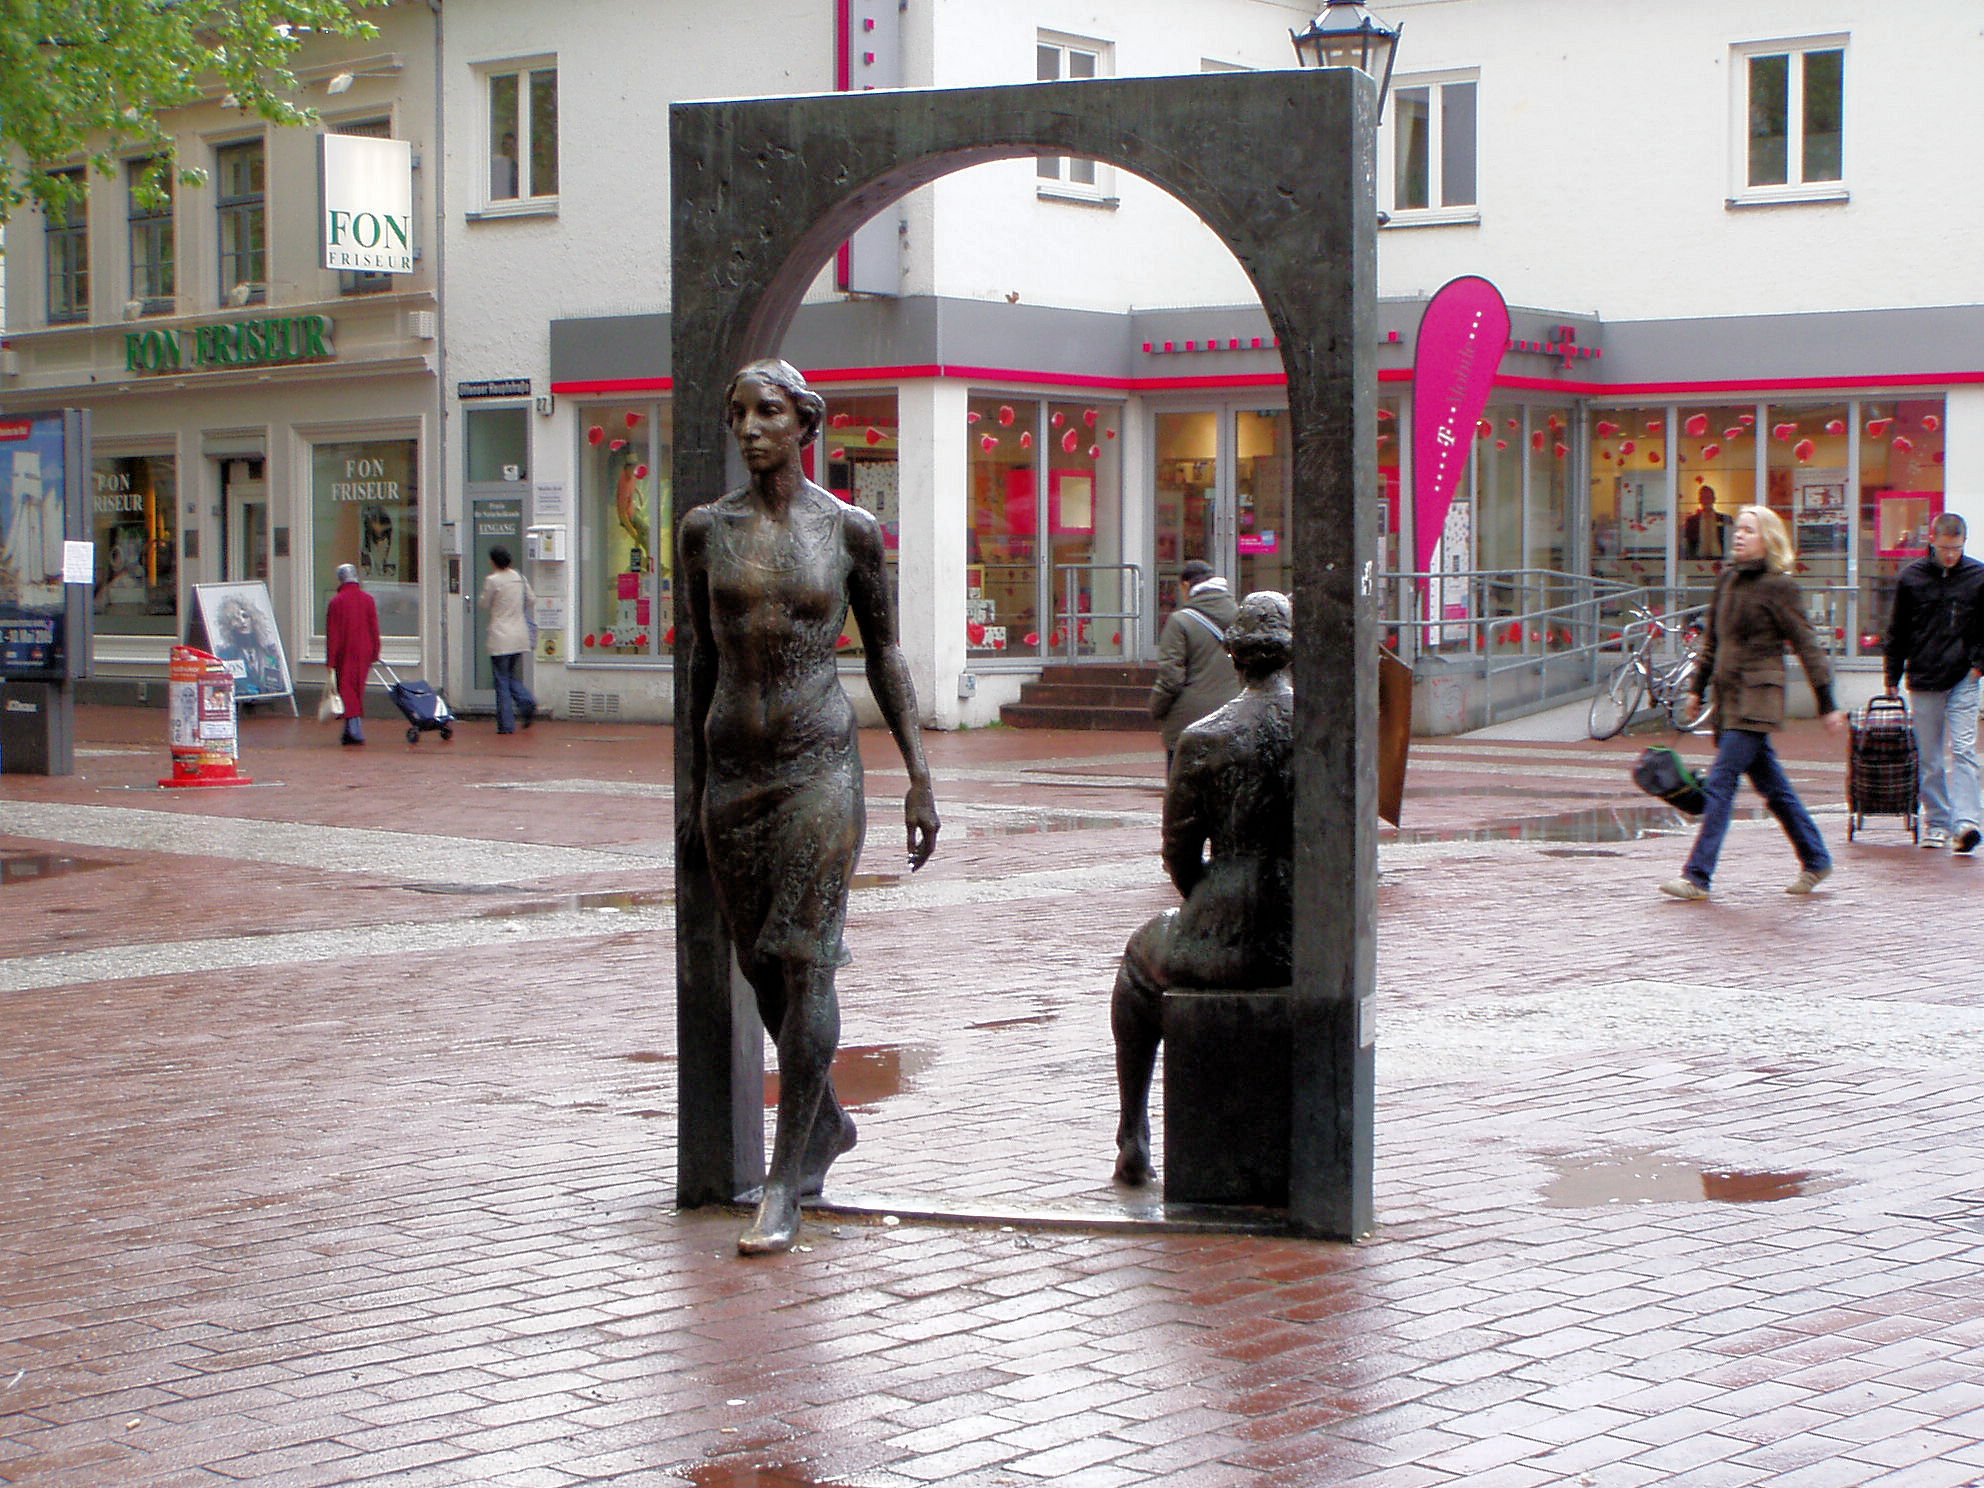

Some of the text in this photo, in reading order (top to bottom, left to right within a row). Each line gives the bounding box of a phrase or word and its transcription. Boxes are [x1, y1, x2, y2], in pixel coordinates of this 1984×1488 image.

[328, 209, 410, 250] FON
[329, 251, 410, 269] FRISEUR
[125, 314, 335, 372] FON FRISEUR
[345, 458, 384, 478] FON
[331, 481, 400, 501] FRISEUR
[94, 493, 144, 512] RISEUR
